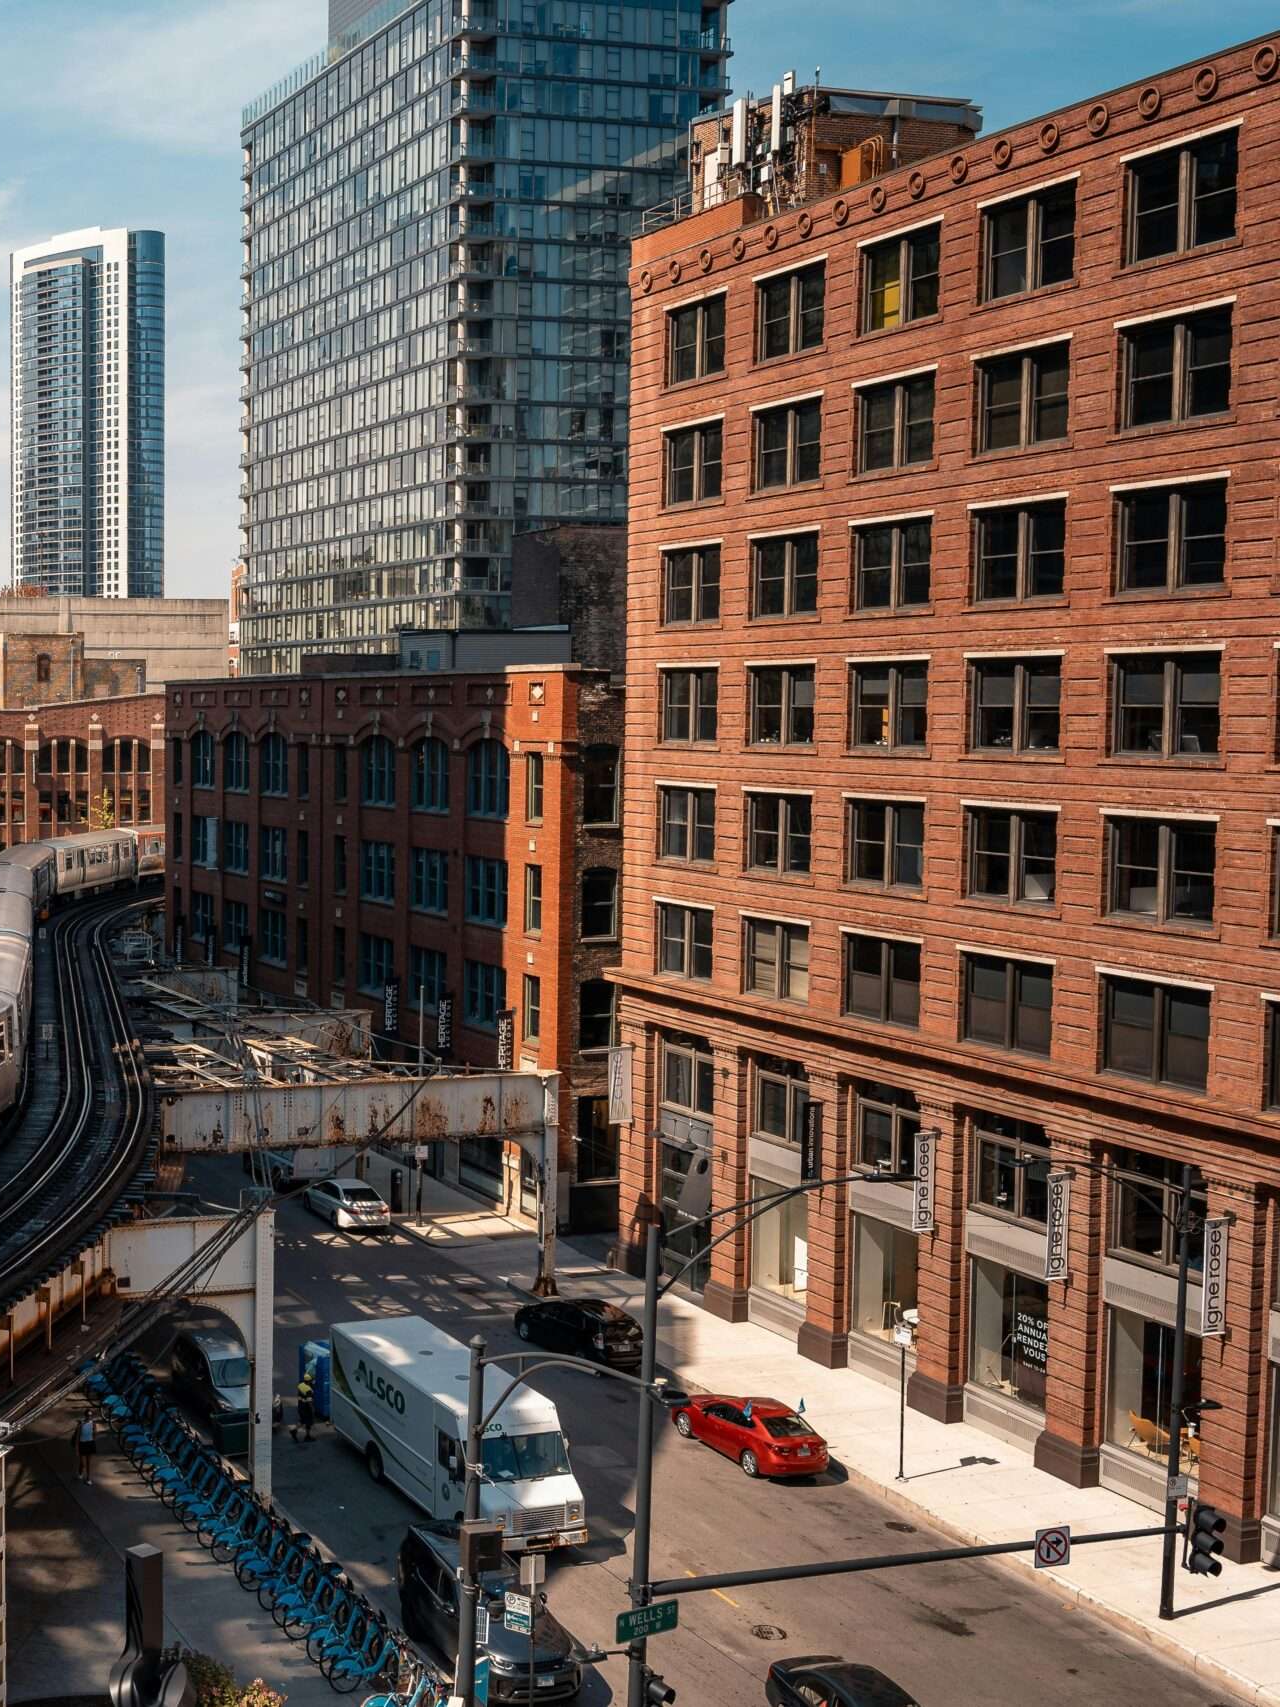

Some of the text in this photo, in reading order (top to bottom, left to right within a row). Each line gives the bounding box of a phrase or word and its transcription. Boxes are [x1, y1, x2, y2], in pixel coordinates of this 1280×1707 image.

[385, 984, 394, 1031] HERITAGE
[438, 999, 447, 1048] HERITAGE
[498, 1018, 507, 1070] HERITAGE
[808, 1106, 816, 1147] innovations
[914, 1135, 932, 1229] ligne roset
[1048, 1175, 1065, 1277] ligne roset
[1204, 1220, 1225, 1332] ligne roset
[1017, 1312, 1035, 1326] 20%
[1023, 1345, 1046, 1362] VOUS
[354, 1359, 406, 1415] ALSCO
[484, 1423, 503, 1433] SCO
[628, 1607, 664, 1627] WELLS
[665, 1604, 677, 1615] ST
[633, 1624, 649, 1636] 200
